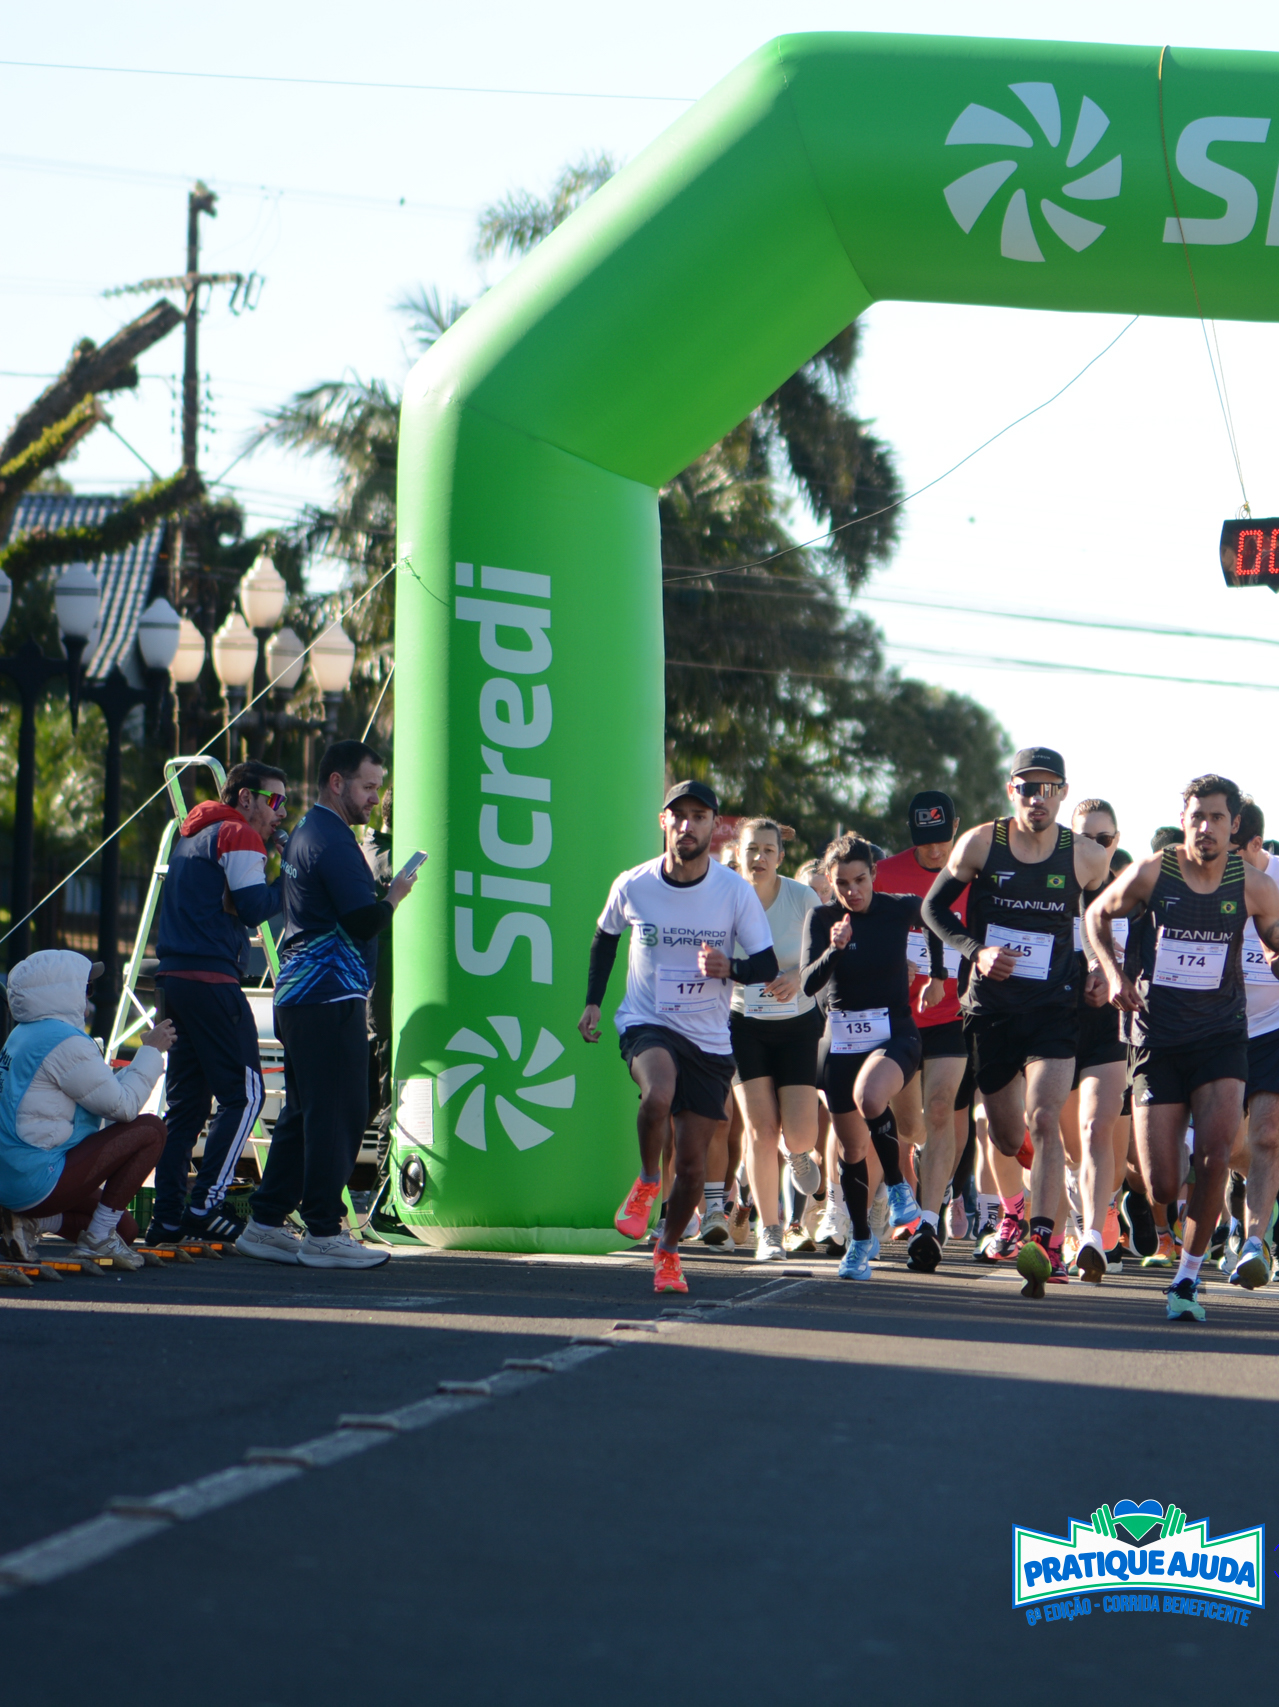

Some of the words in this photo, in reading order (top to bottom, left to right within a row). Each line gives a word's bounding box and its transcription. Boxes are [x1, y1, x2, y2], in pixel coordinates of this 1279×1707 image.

[454, 561, 553, 985] Sicredi
[991, 895, 1065, 912] TITANIUM
[662, 927, 727, 938] LEONARDO
[1177, 954, 1206, 968] 174
[1246, 952, 1268, 965] 22
[677, 982, 705, 995] 177
[758, 988, 774, 998] 23
[846, 1022, 872, 1035] 135
